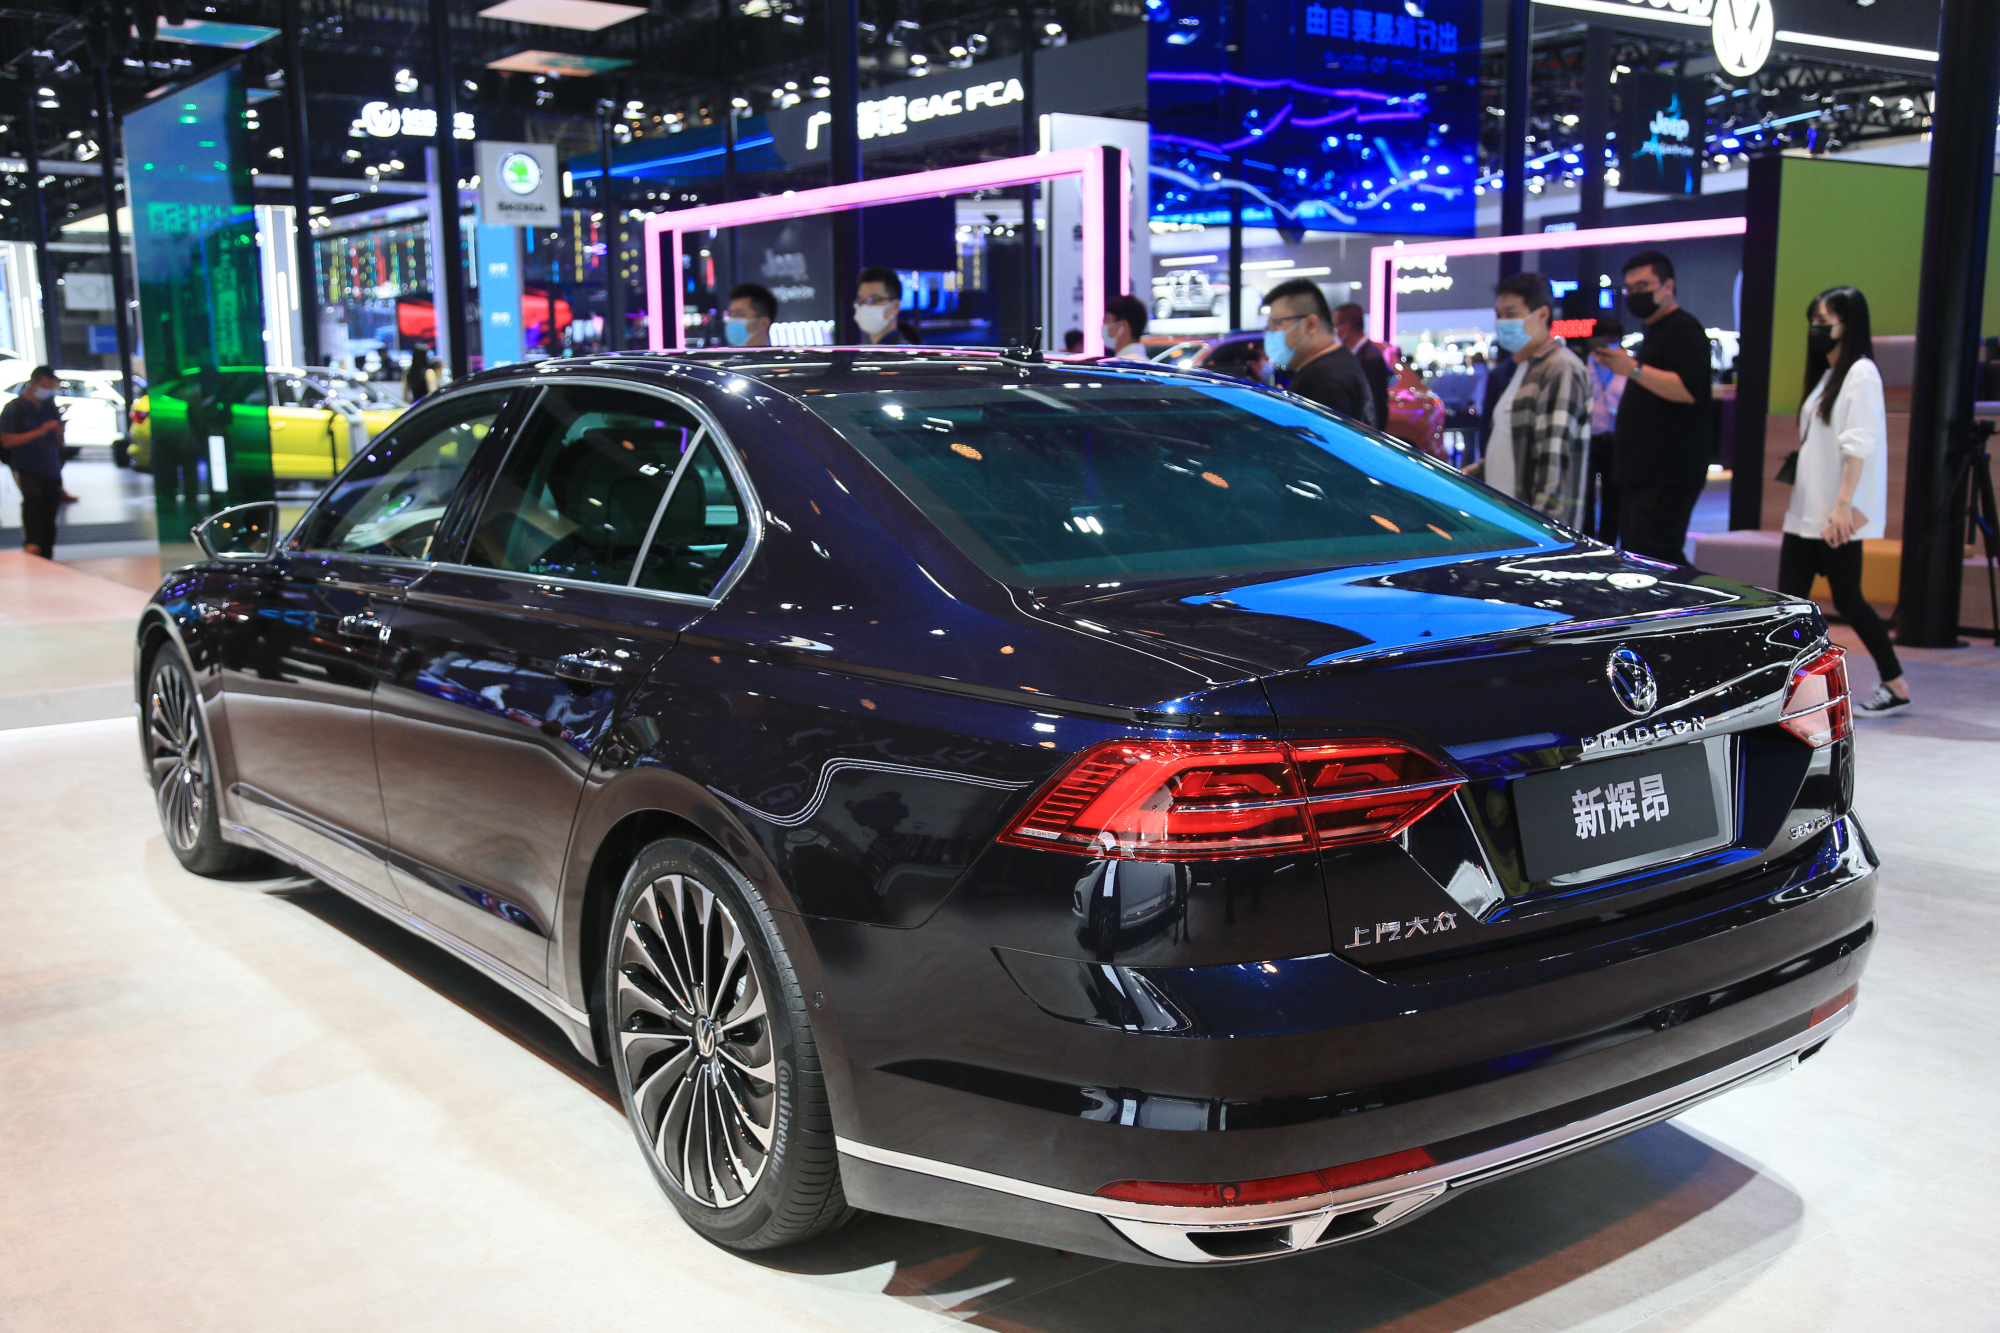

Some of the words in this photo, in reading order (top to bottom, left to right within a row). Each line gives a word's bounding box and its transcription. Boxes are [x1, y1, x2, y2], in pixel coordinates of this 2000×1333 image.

[907, 90, 963, 122] GAC
[965, 78, 1024, 112] FCA
[1649, 110, 1690, 141] Jeep
[1581, 715, 1706, 752] PHIDEON
[1571, 773, 1670, 840] 新辉昂
[1344, 911, 1457, 949] 上汽大众
[768, 1059, 794, 1185] Continental
